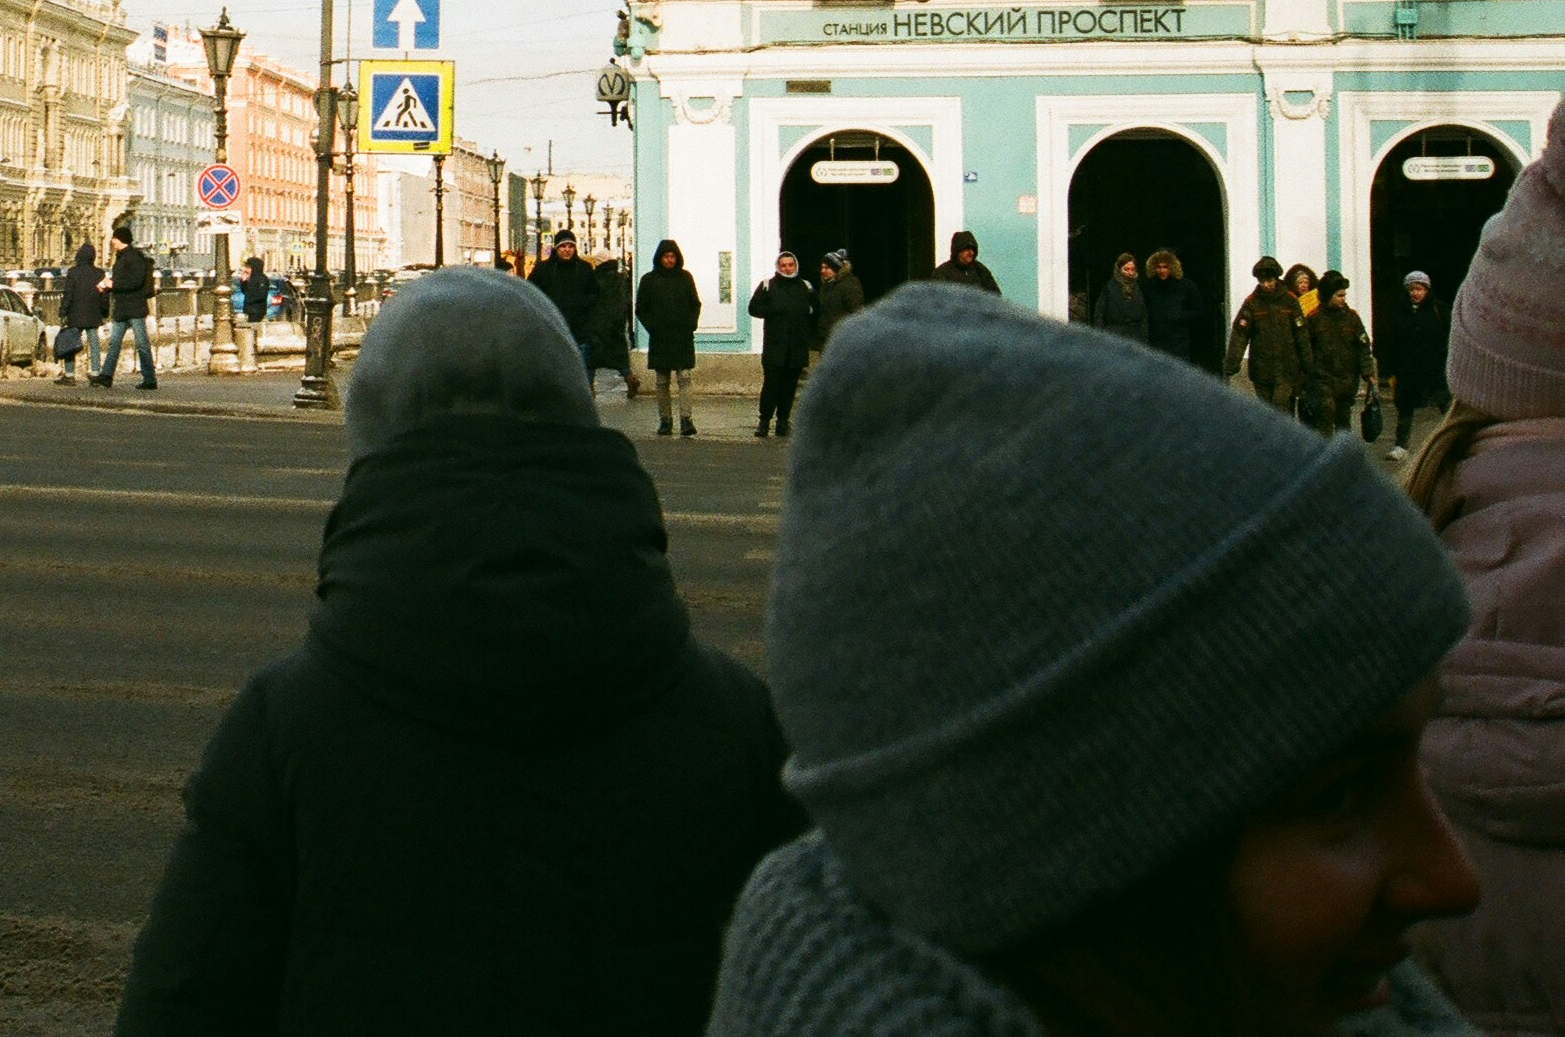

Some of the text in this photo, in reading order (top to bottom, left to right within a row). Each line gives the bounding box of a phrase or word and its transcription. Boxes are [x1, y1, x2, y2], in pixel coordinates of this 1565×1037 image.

[823, 8, 1186, 37] СТАНЦИЯ НЕВСКИЙ ПРОСПЕКТ
